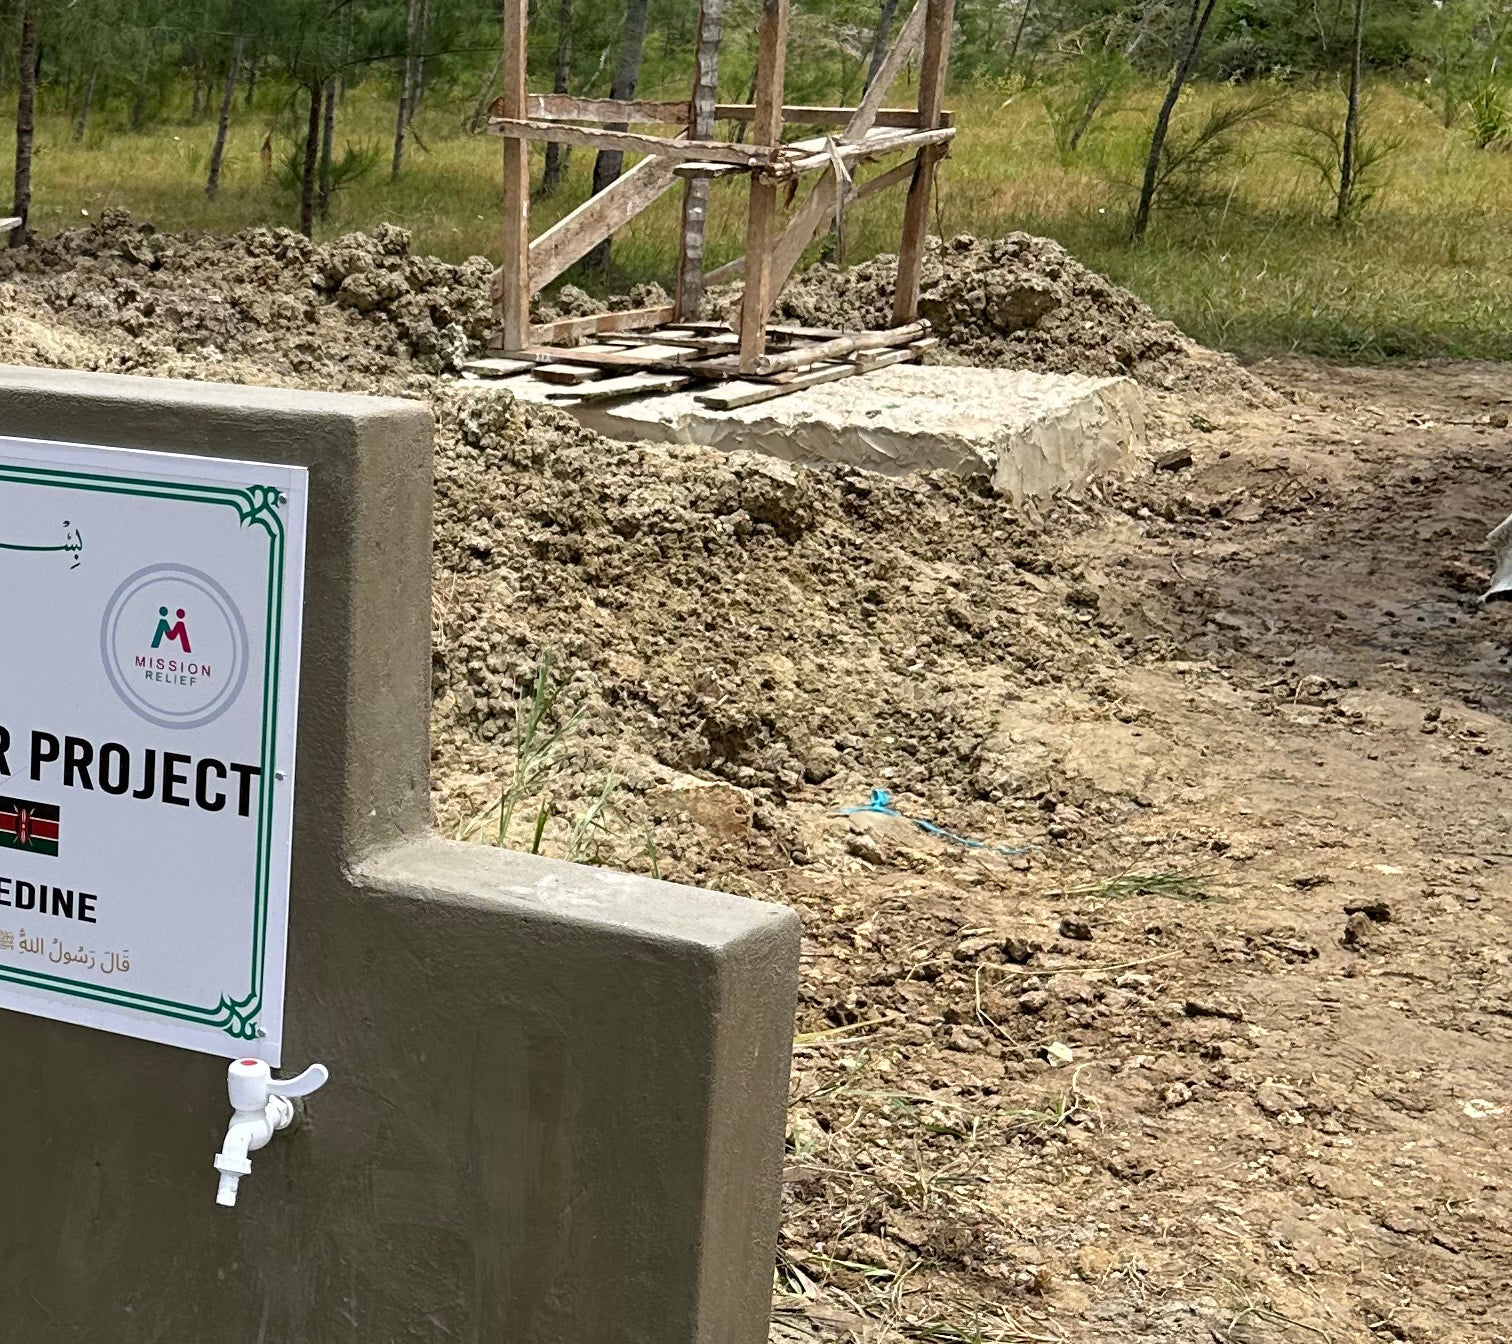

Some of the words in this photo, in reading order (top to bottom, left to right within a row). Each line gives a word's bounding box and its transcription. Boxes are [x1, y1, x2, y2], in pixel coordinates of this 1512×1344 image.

[134, 655, 212, 677] MISSION
[144, 670, 197, 687] RELIEF
[30, 730, 262, 818] PROJECT
